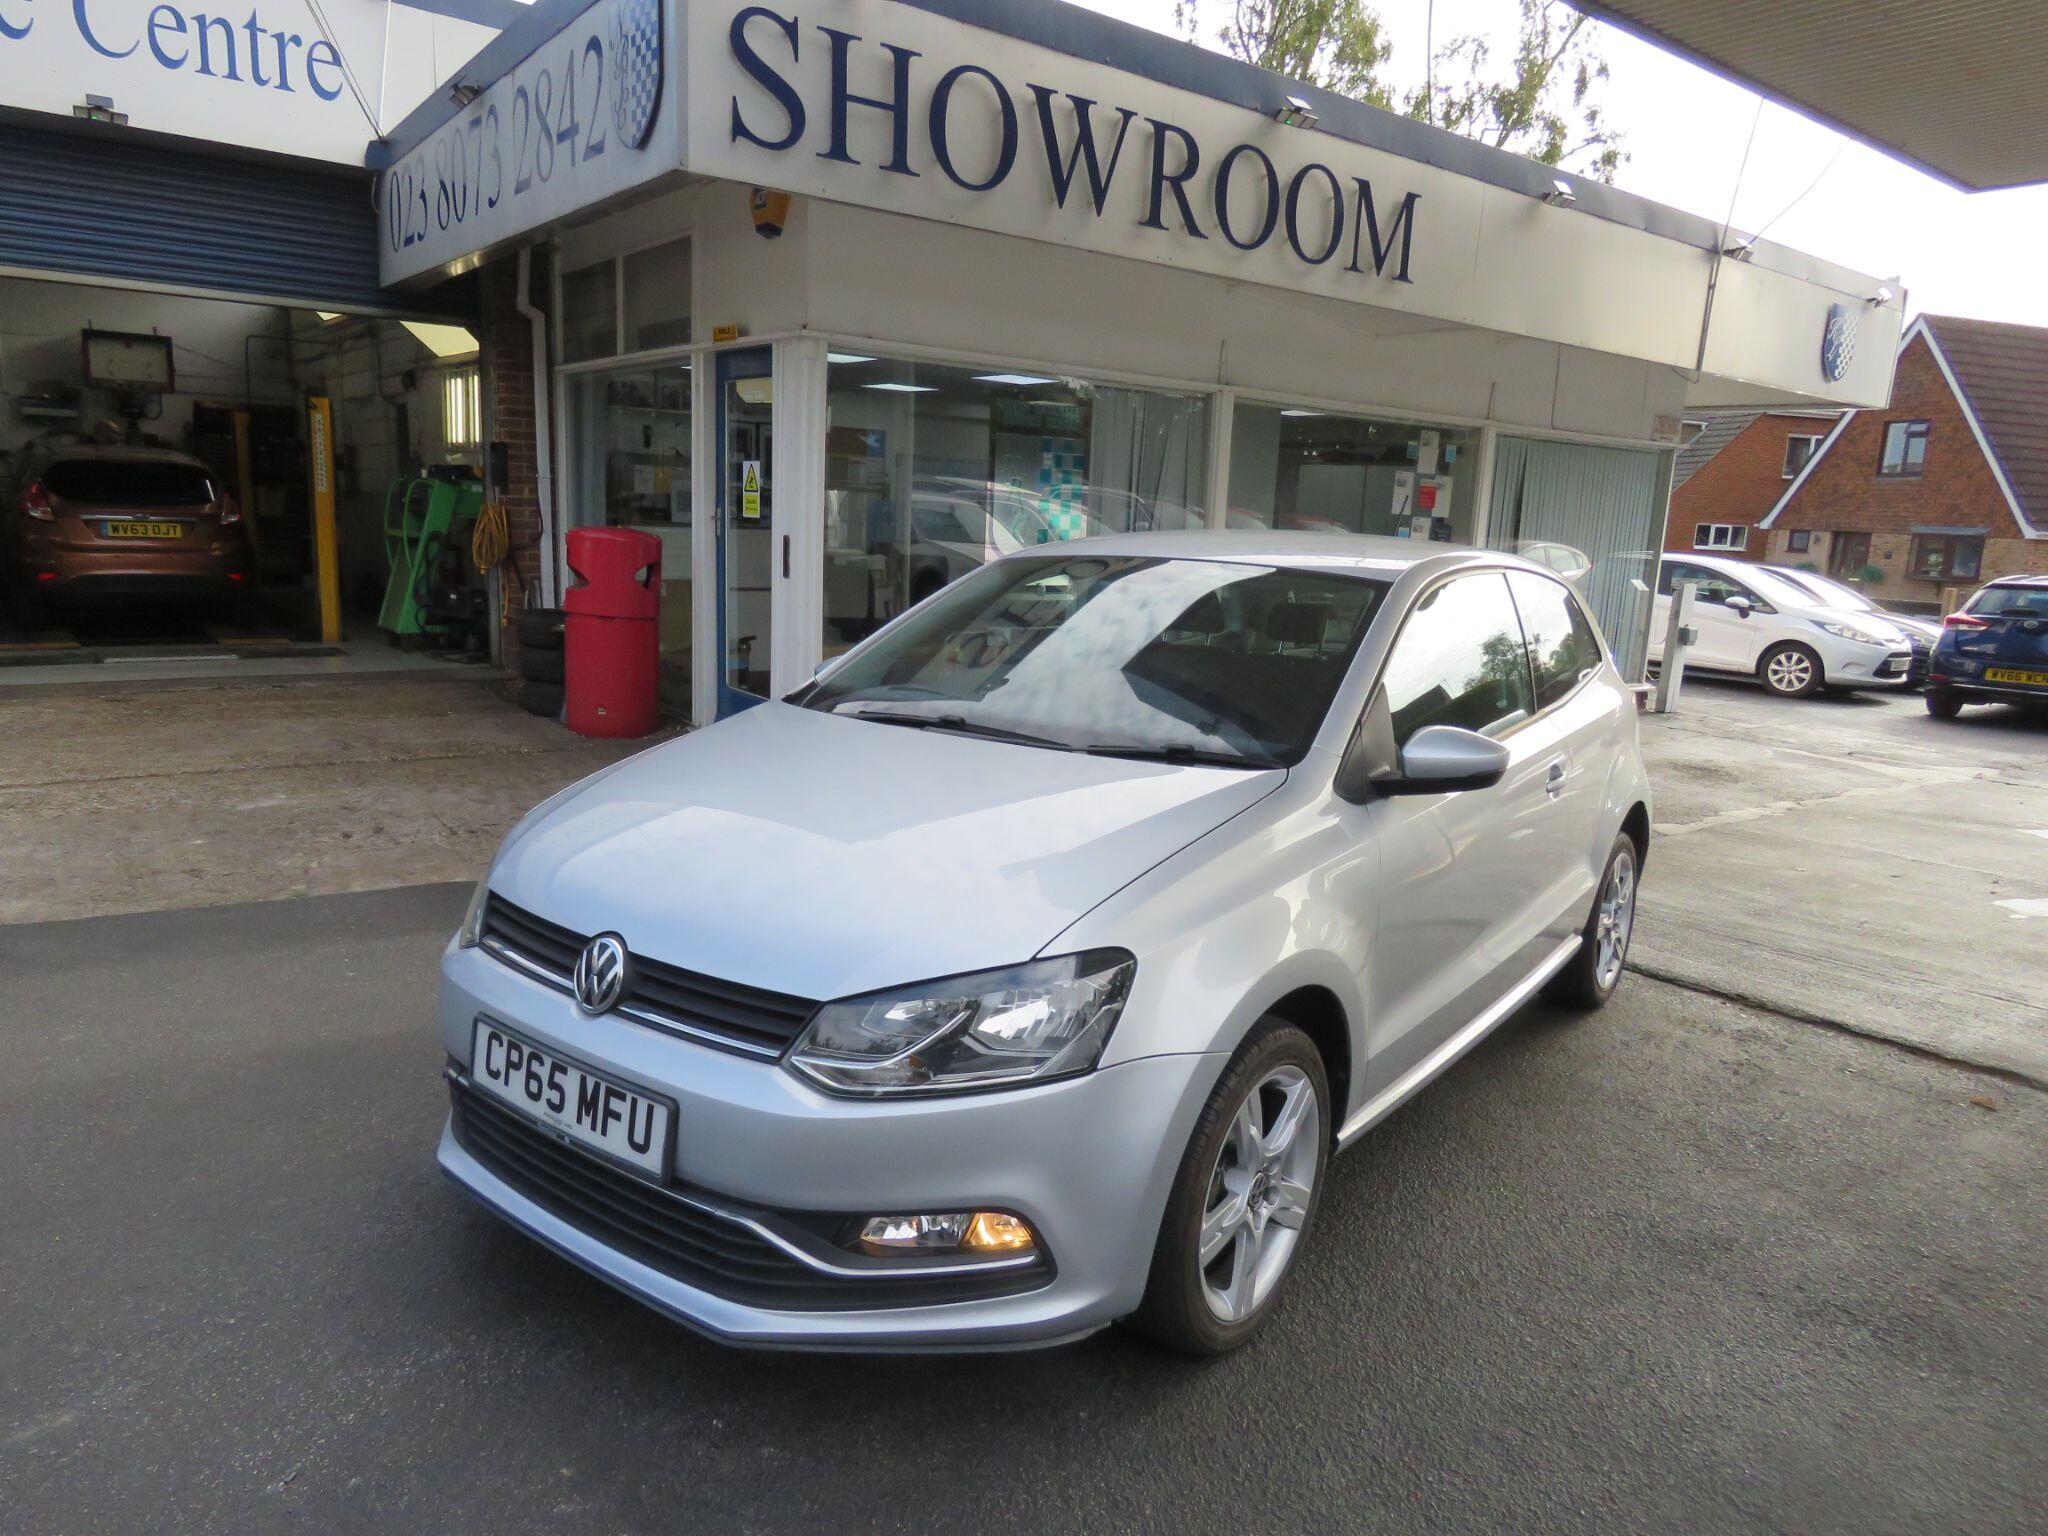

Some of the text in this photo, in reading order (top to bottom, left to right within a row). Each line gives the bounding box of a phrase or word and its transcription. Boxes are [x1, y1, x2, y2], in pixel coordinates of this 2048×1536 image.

[72, 0, 344, 101] Centre
[390, 153, 428, 253] 023
[435, 104, 501, 231] 8073
[513, 35, 606, 195] 2842
[729, 6, 1422, 284] SHOWROOM
[485, 1030, 655, 1155] CP65 MFU
